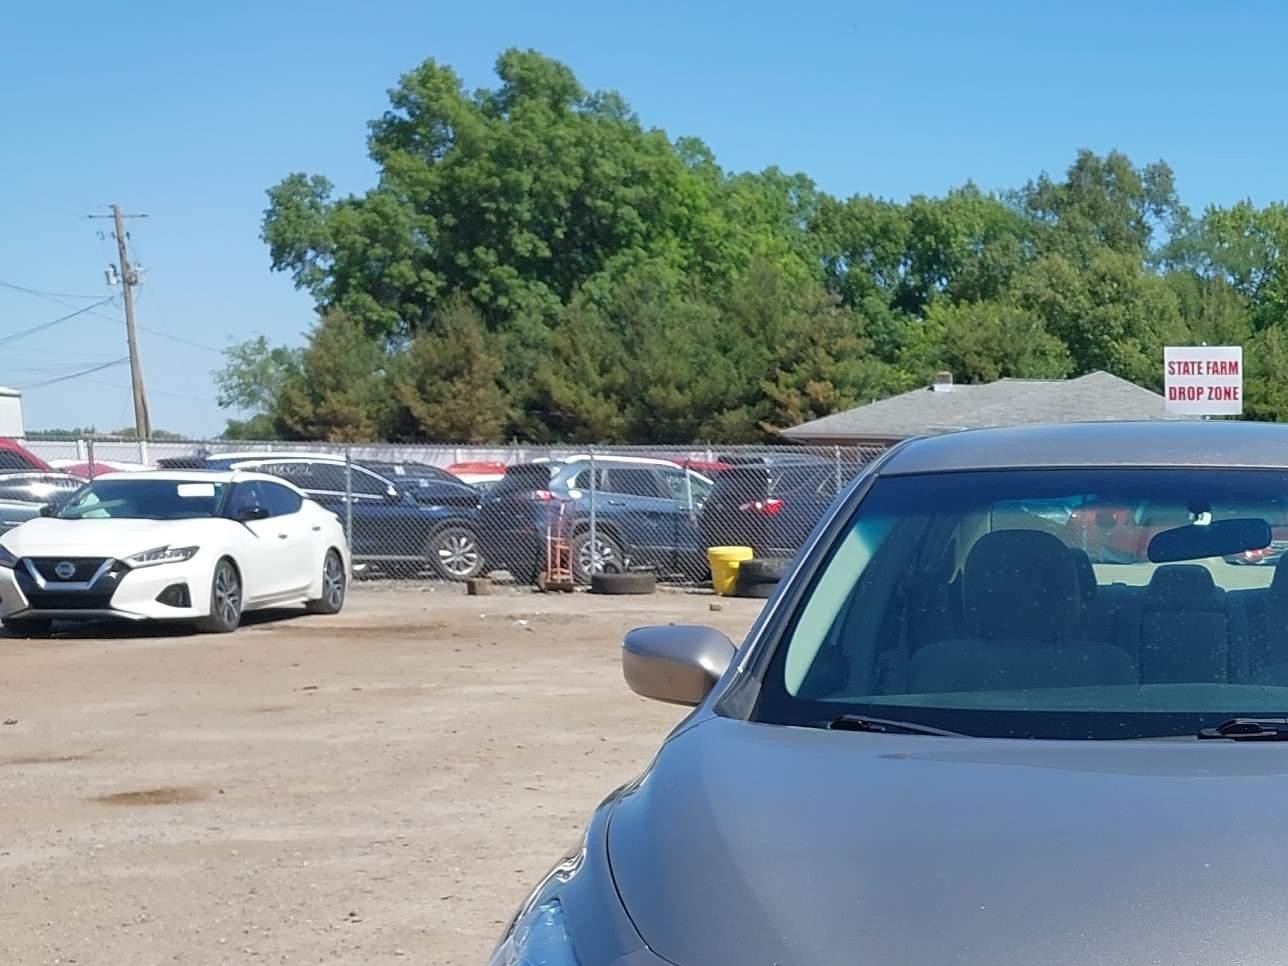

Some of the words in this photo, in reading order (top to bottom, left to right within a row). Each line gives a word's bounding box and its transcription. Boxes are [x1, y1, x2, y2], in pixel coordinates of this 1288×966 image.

[1168, 361, 1203, 375] STATE
[1206, 361, 1239, 375] FARM
[1169, 386, 1204, 401] DROP
[1207, 386, 1239, 401] ZONE
